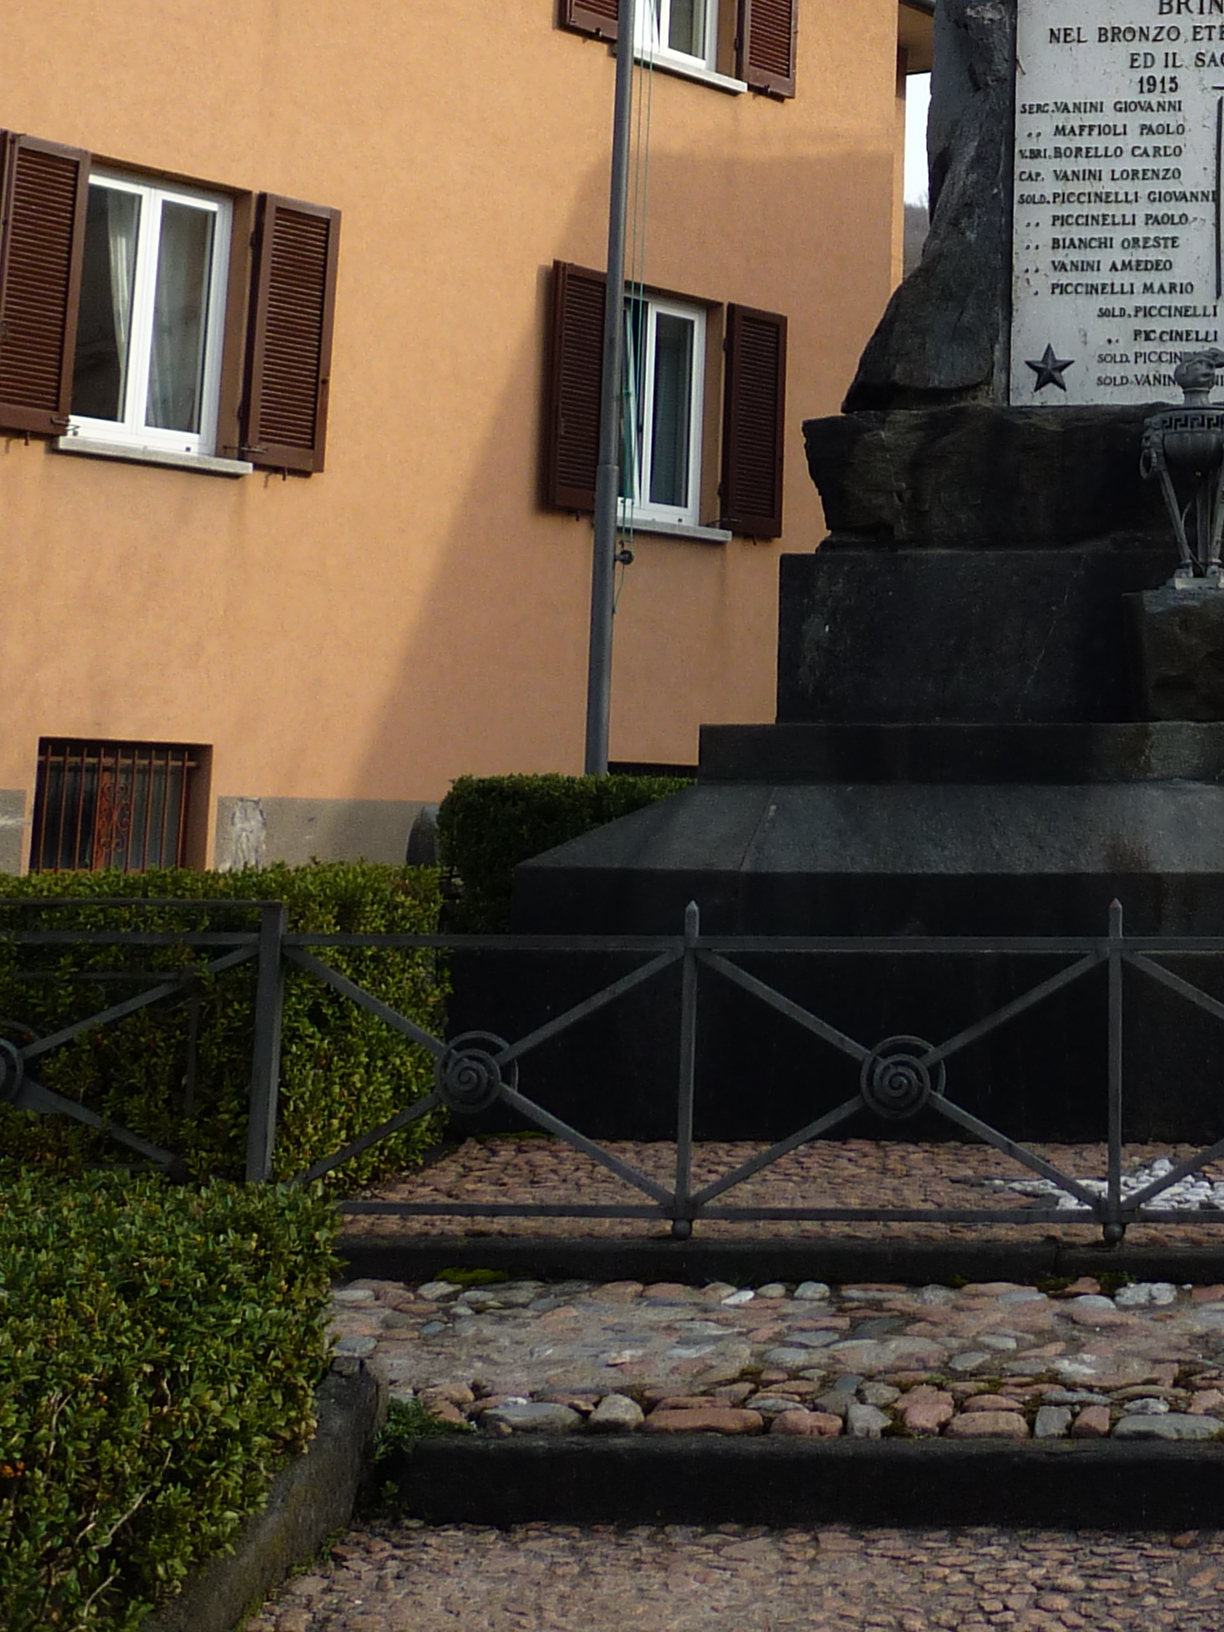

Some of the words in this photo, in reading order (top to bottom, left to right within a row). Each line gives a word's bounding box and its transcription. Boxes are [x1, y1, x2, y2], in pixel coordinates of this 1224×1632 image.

[1049, 27, 1088, 44] NEL
[1129, 52, 1155, 69] ED
[1164, 52, 1183, 68] IL
[1138, 76, 1178, 94] 1915
[1054, 101, 1104, 114] VANINI
[1113, 100, 1182, 113] GIOVANNI
[1053, 124, 1128, 136] MAFFIOLI
[1139, 123, 1186, 136] PAOLO
[1053, 146, 1123, 158] BORELLO
[1131, 145, 1183, 158] CARLO
[1019, 171, 1045, 182] CAP.
[1053, 169, 1102, 181] VANINI
[1110, 168, 1182, 181] LORENZO
[1052, 191, 1140, 204] PICCINELLI
[1147, 190, 1215, 203] GIOVANNI
[1051, 214, 1136, 227] PICCINELLI
[1144, 213, 1189, 226] PAOLO
[1051, 237, 1114, 250] BIANCHI
[1121, 236, 1180, 249] ORESTE
[1051, 260, 1101, 272] VANINI
[1109, 259, 1173, 272] AMEDEO
[1050, 282, 1135, 295] PICCINELLI
[1142, 281, 1194, 294] MARIO
[1133, 305, 1218, 318] PICCINELLI
[1133, 329, 1218, 342] PICCINELLI
[1134, 373, 1180, 386] VANIN
